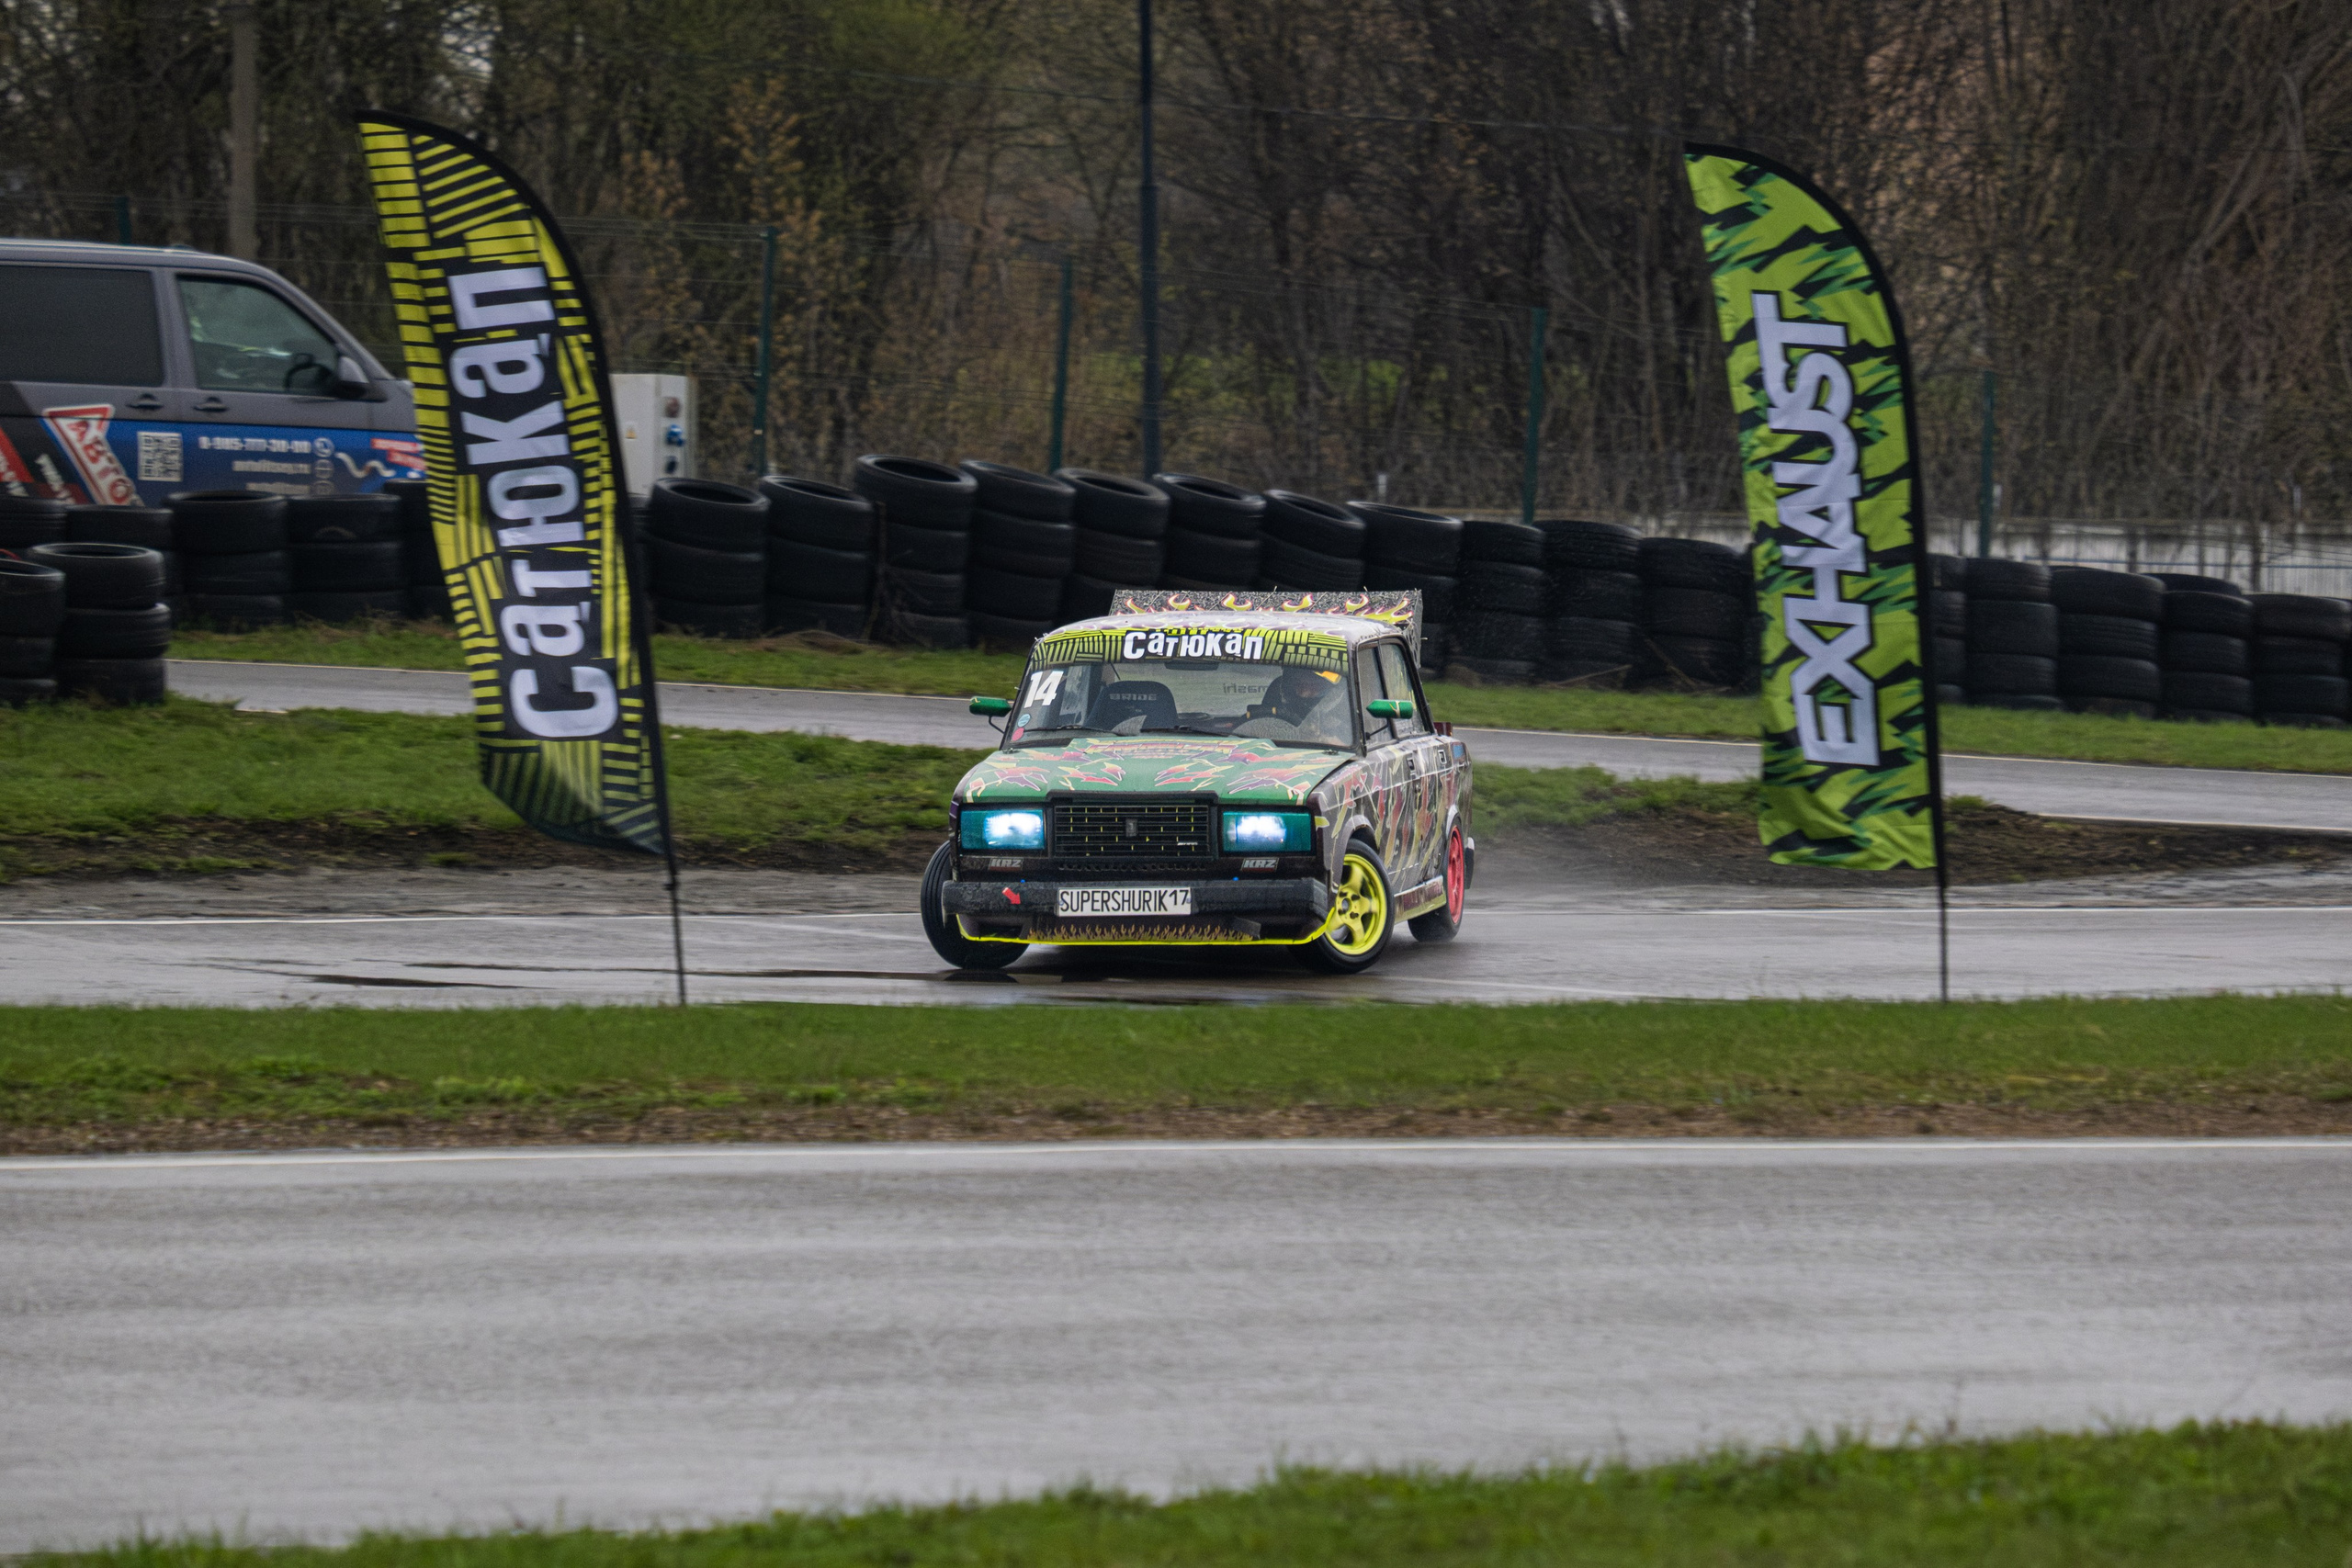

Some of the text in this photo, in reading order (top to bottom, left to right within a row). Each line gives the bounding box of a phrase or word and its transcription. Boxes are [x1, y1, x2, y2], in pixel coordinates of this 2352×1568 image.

[447, 265, 619, 739] Сатюкап
[1751, 290, 1881, 767] EXHAUST
[1023, 671, 1064, 708] 14
[1123, 631, 1263, 660] Сатюкап
